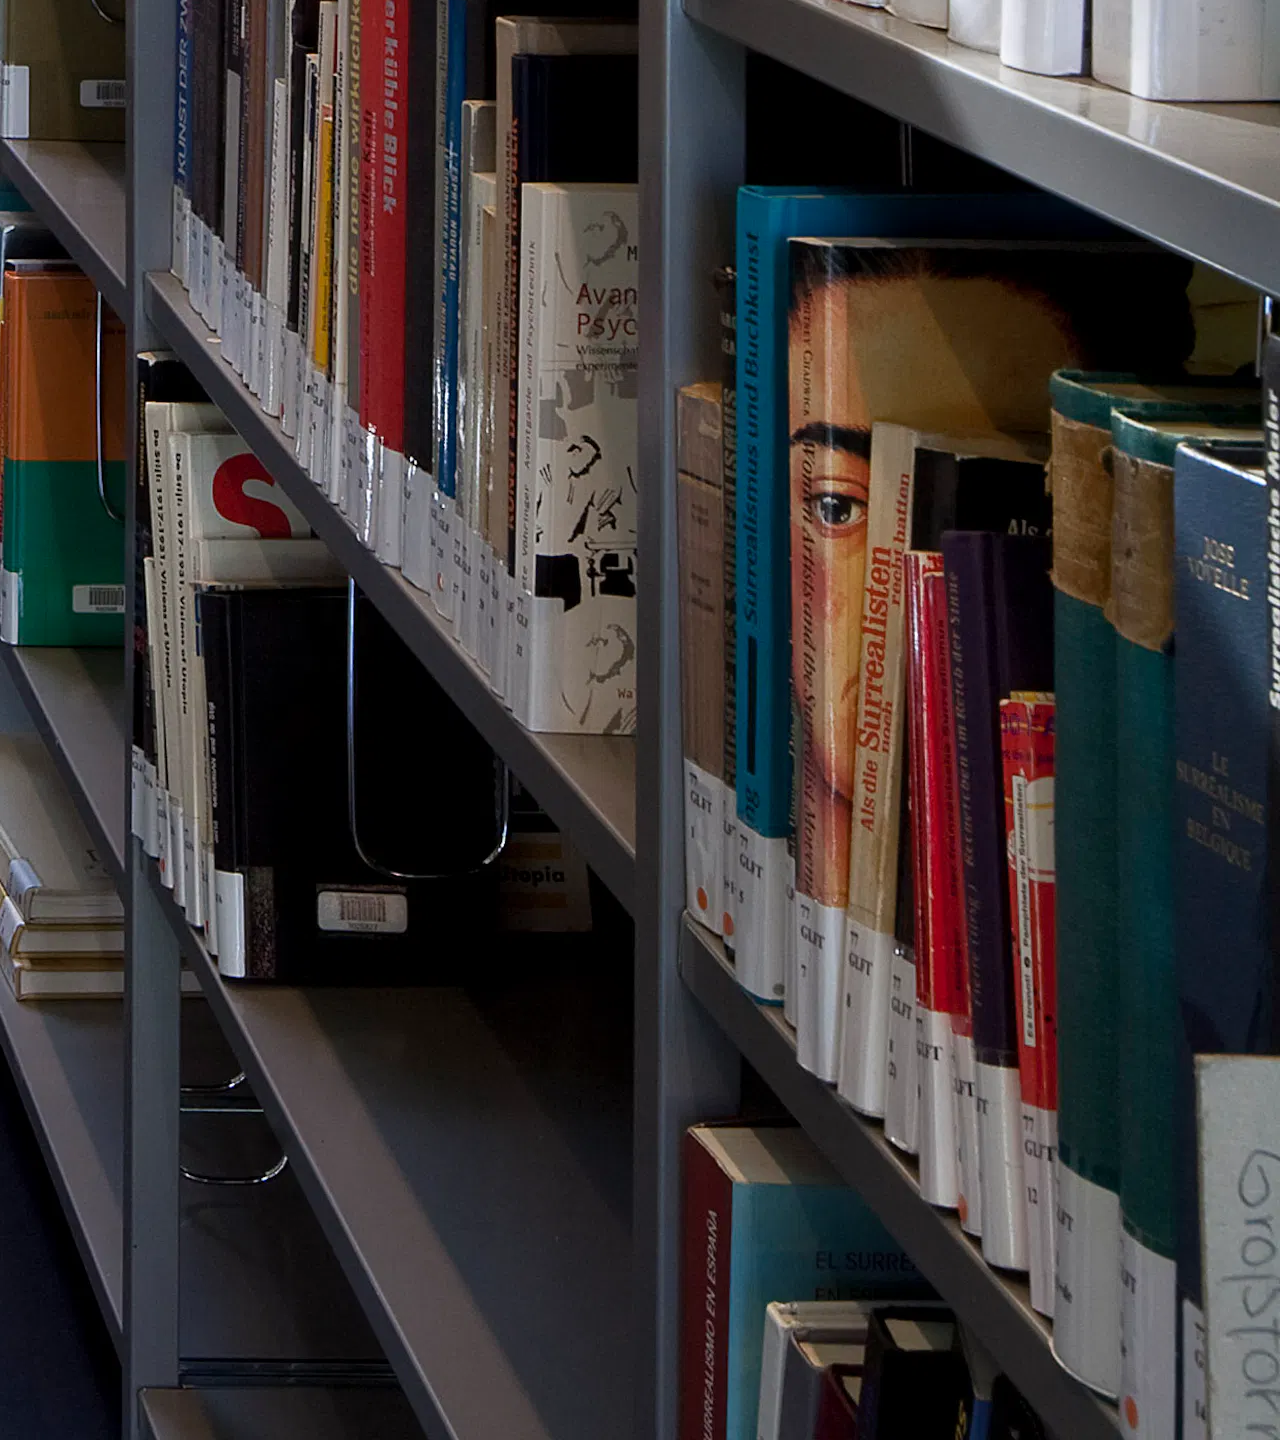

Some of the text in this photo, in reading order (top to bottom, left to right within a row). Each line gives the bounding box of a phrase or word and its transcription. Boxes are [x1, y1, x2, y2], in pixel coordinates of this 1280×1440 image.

[178, 39, 189, 91] DER
[383, 38, 398, 131] kühle
[178, 102, 187, 176] KUNST
[383, 133, 397, 215] Blick
[350, 157, 359, 234] neue
[362, 109, 372, 273] mit voller Kraft
[350, 250, 359, 294] die
[525, 240, 536, 347] Psychotechnik
[525, 353, 533, 380] und
[524, 386, 532, 471] Avantgarde
[743, 231, 760, 630] Surrealismus und Buchkunst
[176, 453, 182, 471] De
[181, 647, 187, 664] of
[799, 440, 817, 804] Women Artists and the Surrealist
[881, 472, 910, 753] noch recht hatten
[857, 546, 891, 831] Als die Surrealisten
[1212, 750, 1229, 777] LE
[740, 853, 764, 879] GLFT
[801, 926, 825, 950] GLFT
[849, 952, 872, 976] GLFT
[892, 996, 912, 1020] GLFT
[1027, 1188, 1038, 1205] 12
[816, 1251, 836, 1270] EL
